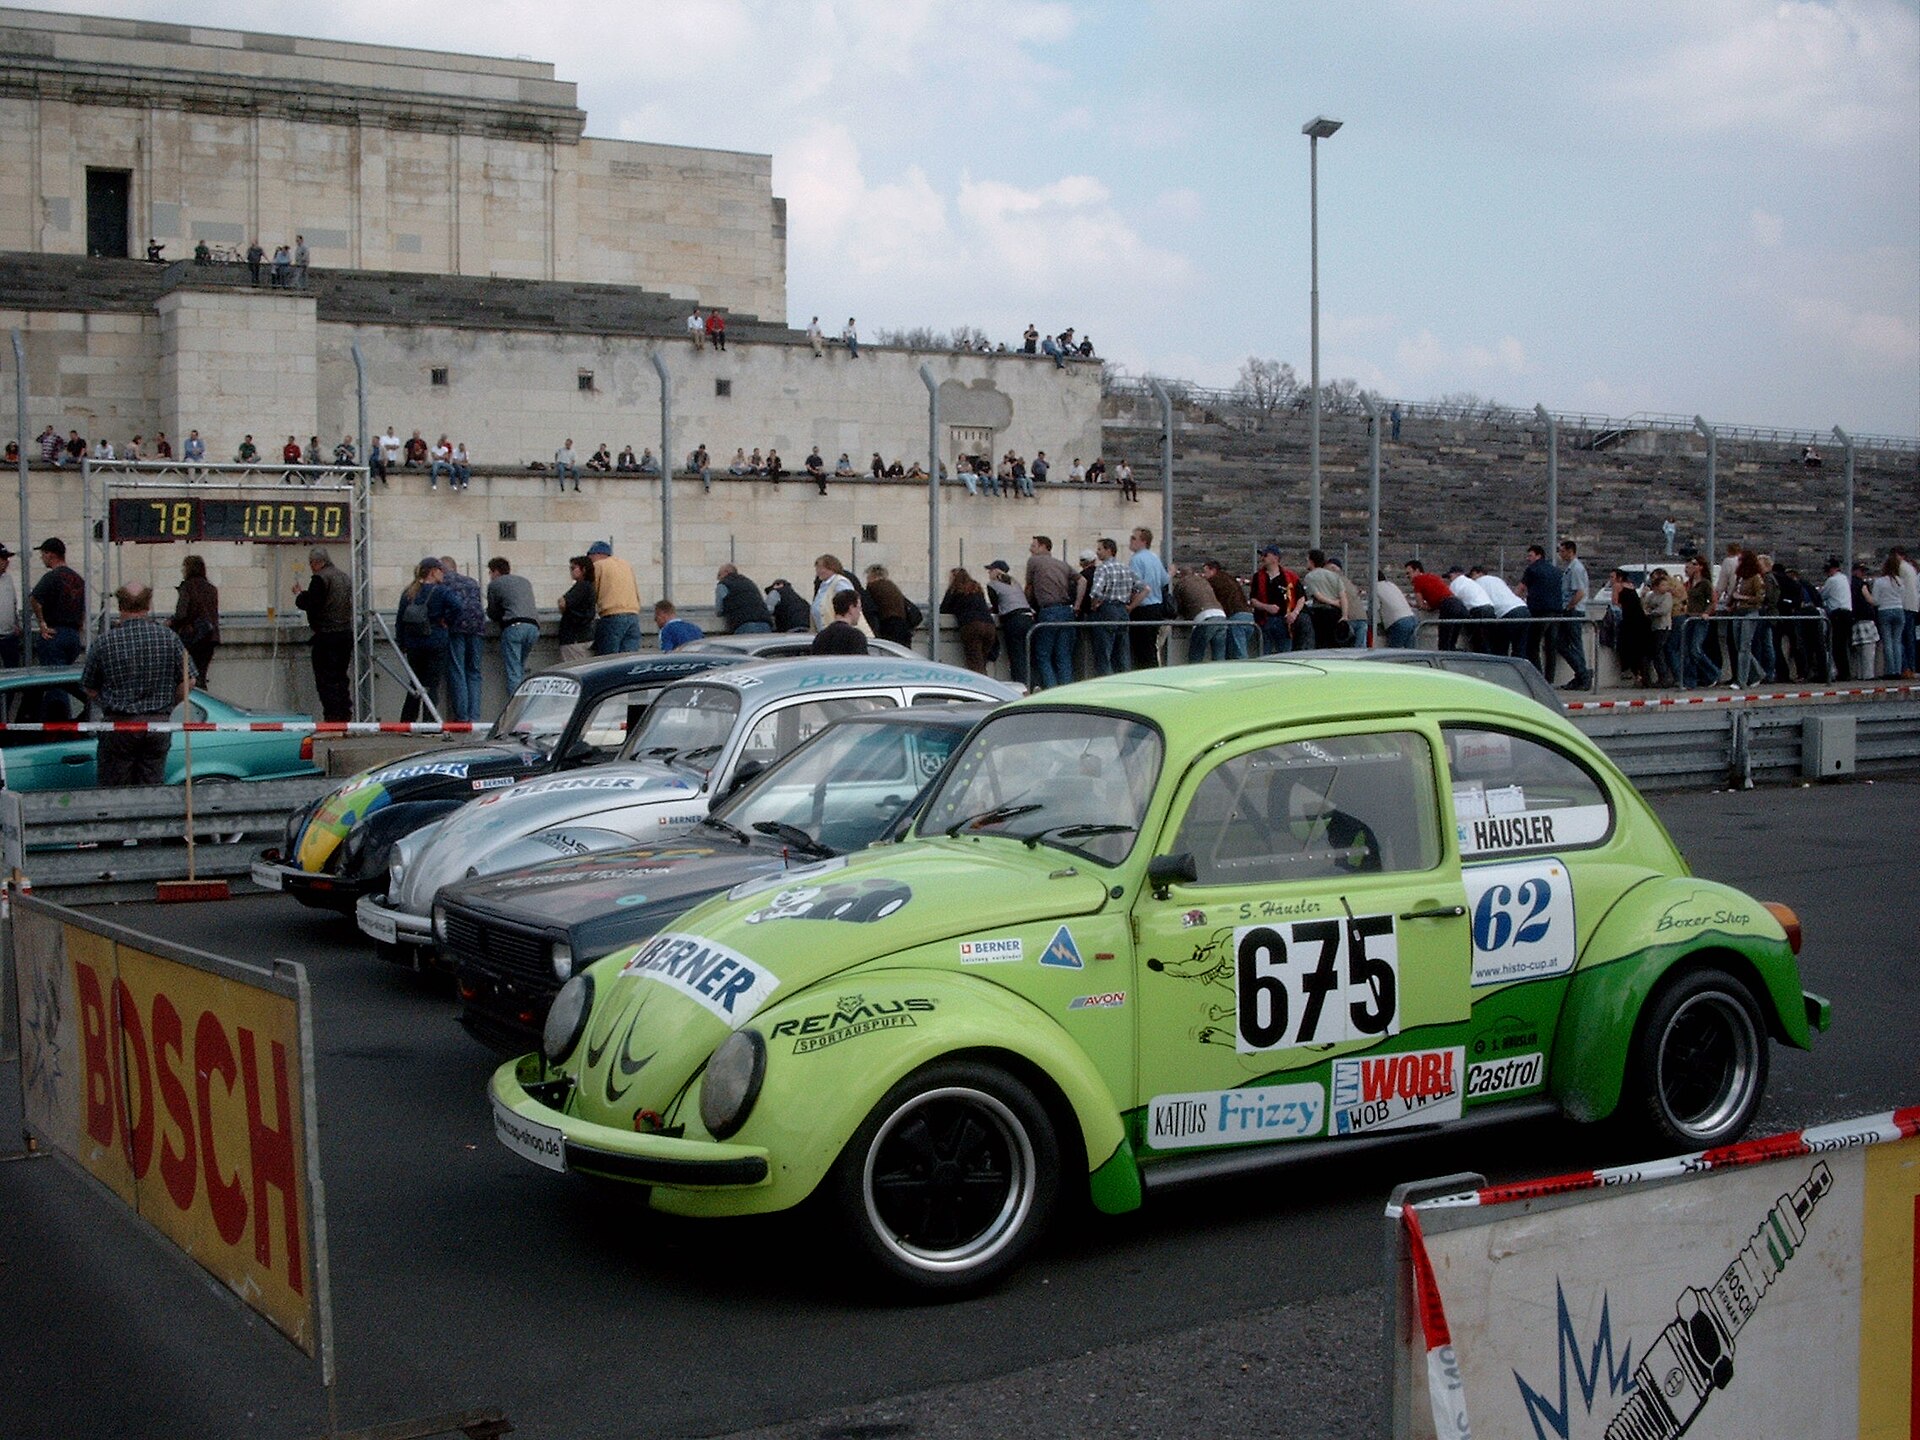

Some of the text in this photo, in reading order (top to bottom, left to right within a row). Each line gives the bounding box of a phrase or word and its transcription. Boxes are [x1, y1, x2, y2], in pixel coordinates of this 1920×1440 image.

[151, 503, 192, 535] 78
[798, 669, 972, 688] Boxer Shop
[483, 777, 514, 788] BERNER
[669, 815, 702, 824] BERNER
[1474, 814, 1555, 850] HÄUSLER
[1473, 878, 1552, 952] 62
[1655, 910, 1750, 932] Boxer Shop
[975, 941, 1020, 952] BERNER
[637, 938, 756, 1014] BERNER
[1237, 915, 1397, 1048] 675
[1476, 957, 1558, 978] www.histo-cup.at
[1084, 992, 1125, 1006] AVON
[770, 998, 937, 1040] REMUS
[800, 1016, 909, 1051] SPORTAUSPUFF
[1362, 1051, 1454, 1102] WOB!
[1467, 1054, 1541, 1095] Castrol
[76, 962, 304, 1297] BOSCH
[1155, 1094, 1319, 1138] KATTUS Frizzy
[1350, 1100, 1390, 1130] WOB
[1725, 1267, 1754, 1319] BOSCH
